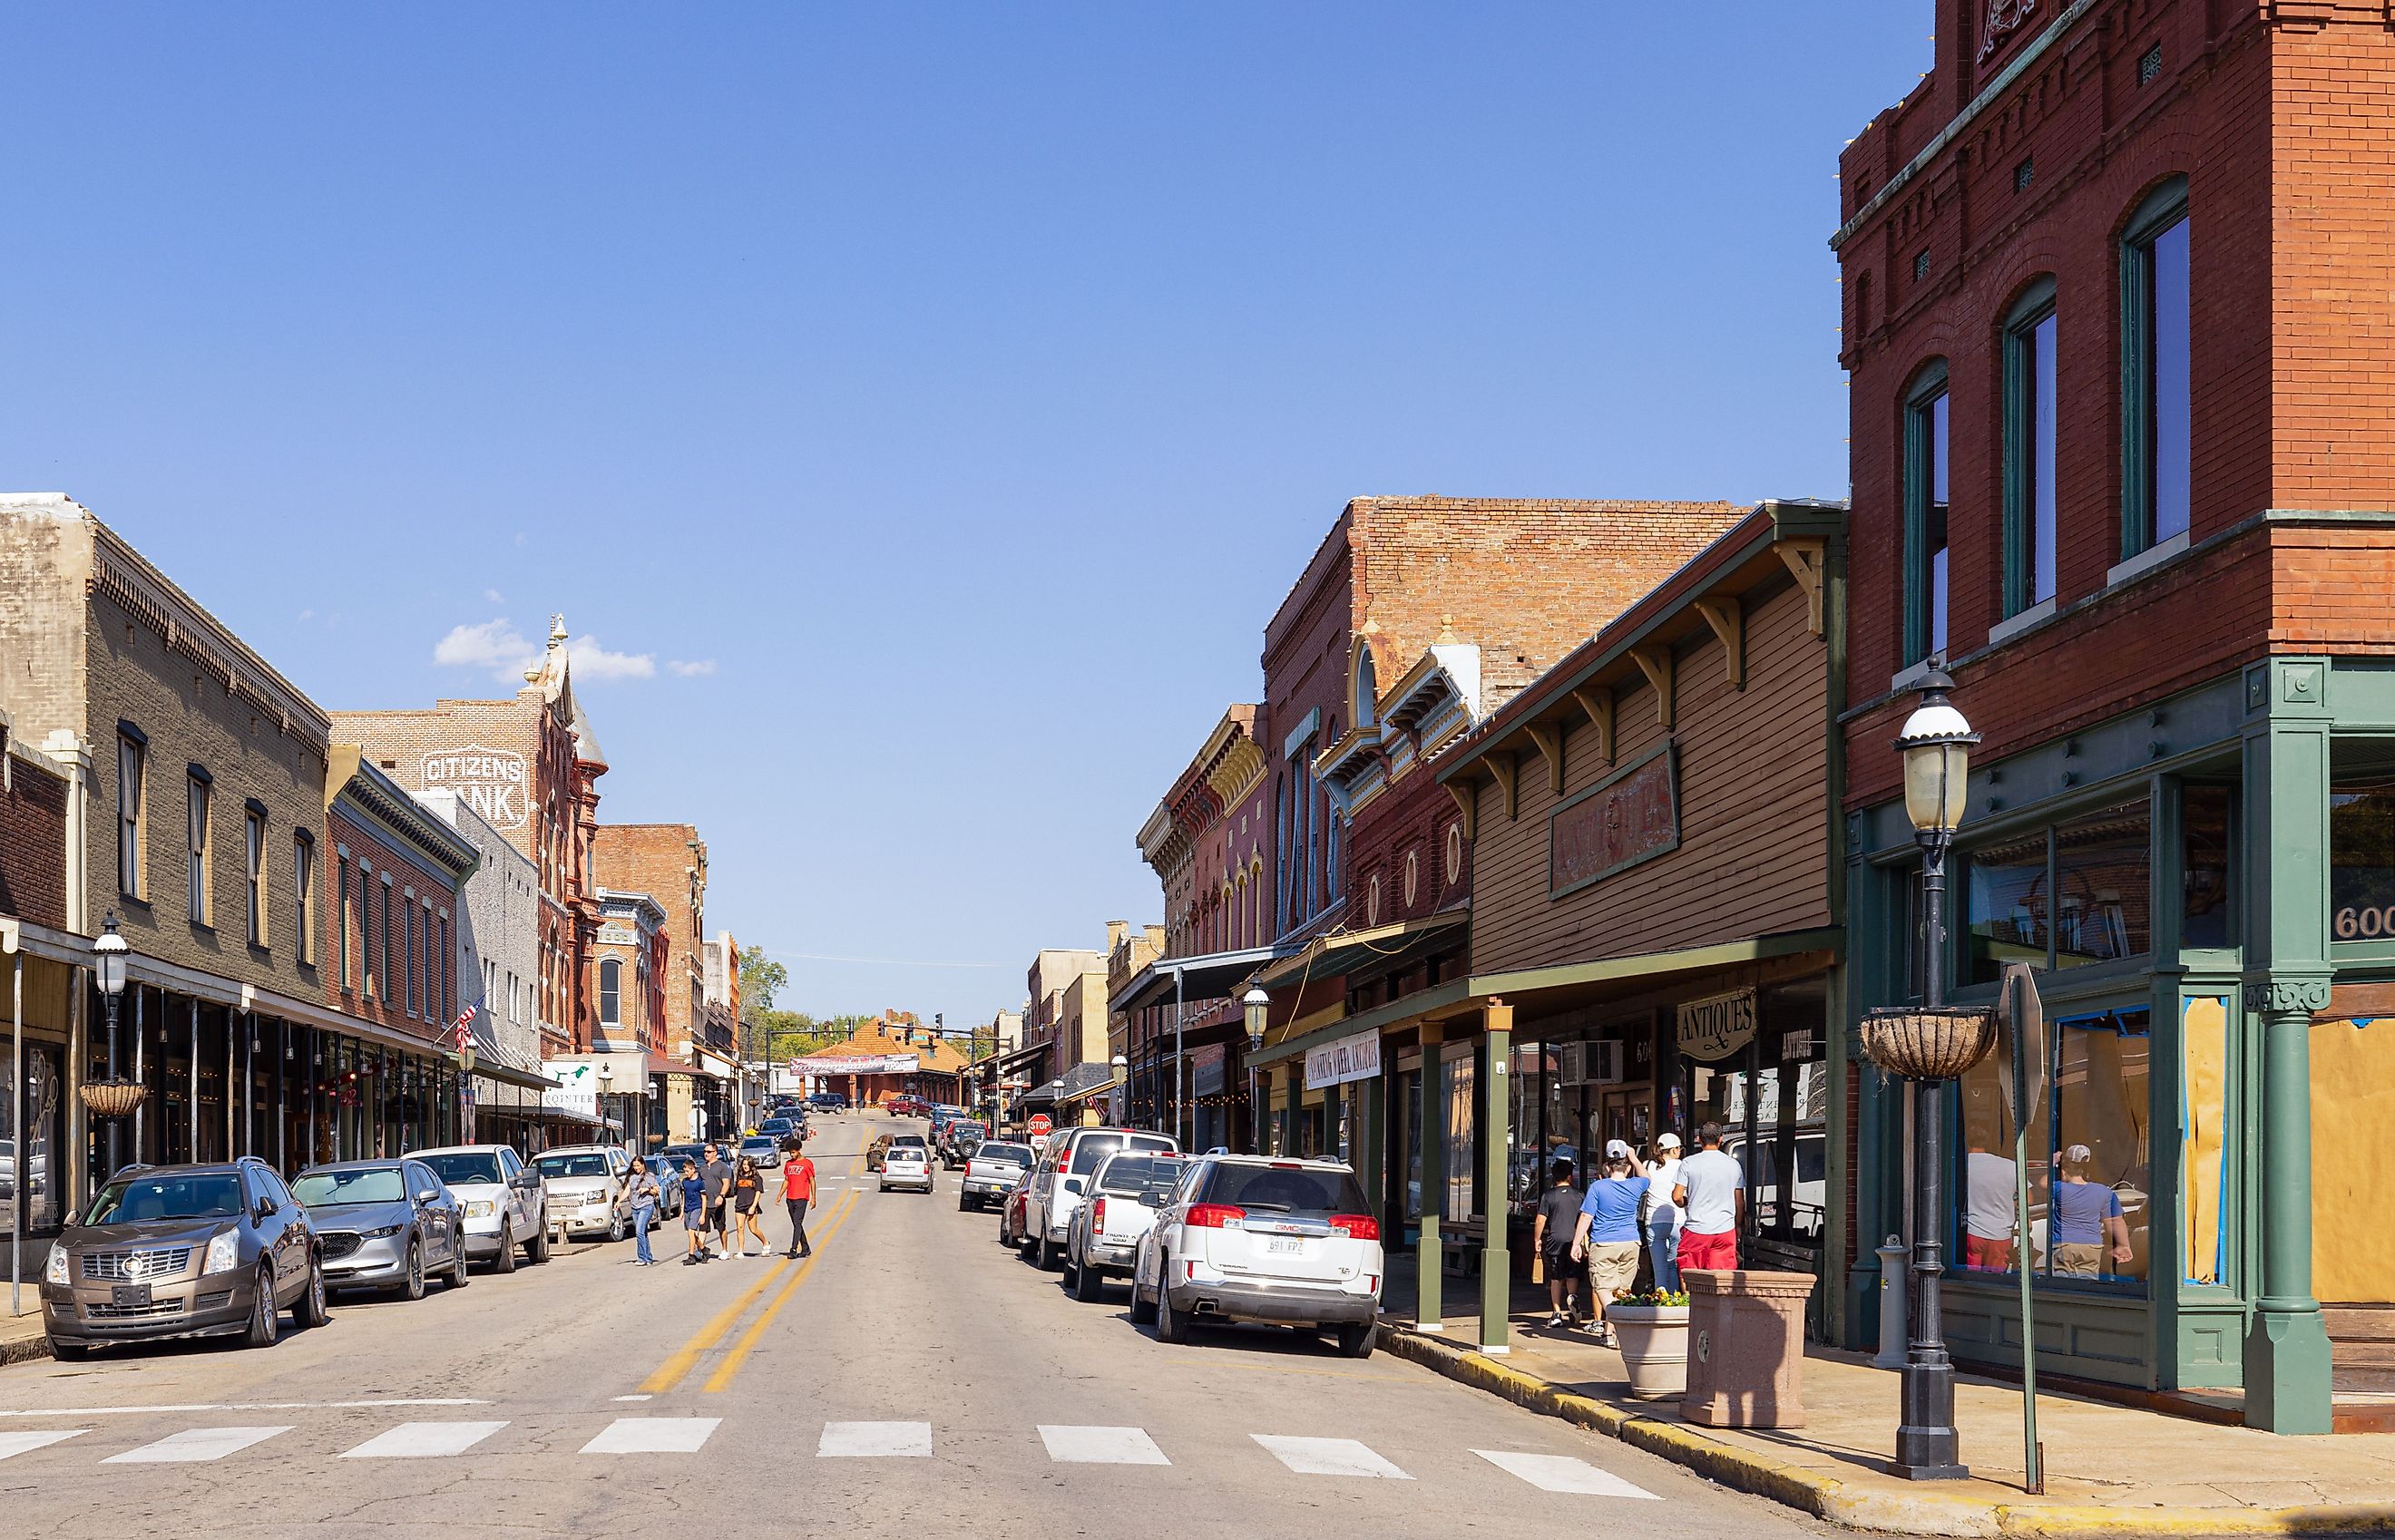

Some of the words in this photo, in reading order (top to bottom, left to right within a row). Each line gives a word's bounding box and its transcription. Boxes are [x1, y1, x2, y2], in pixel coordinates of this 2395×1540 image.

[426, 756, 522, 782] CITIZENS
[1681, 998, 1753, 1042] ANTIQUES
[545, 1094, 593, 1104] POINTER
[1030, 1121, 1050, 1130] STOP
[1269, 1241, 1283, 1251] 691
[1287, 1242, 1304, 1252] FPZ
